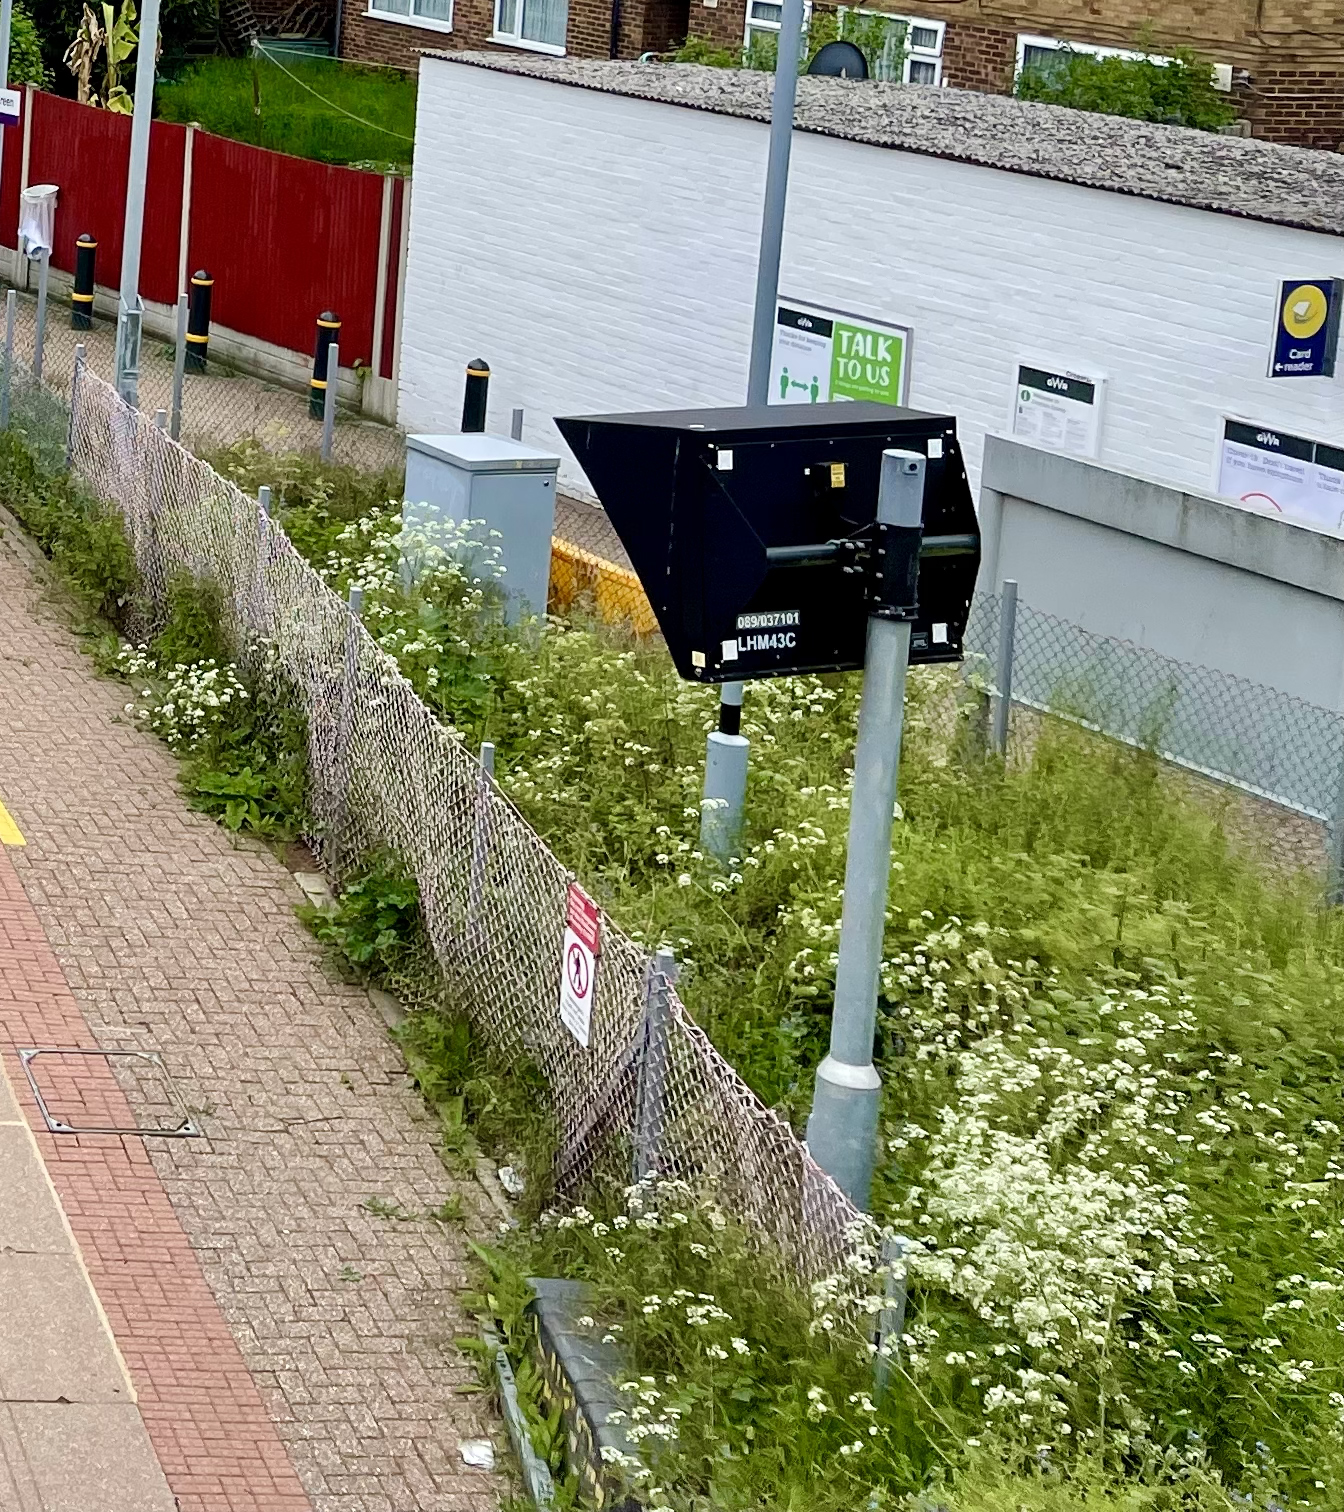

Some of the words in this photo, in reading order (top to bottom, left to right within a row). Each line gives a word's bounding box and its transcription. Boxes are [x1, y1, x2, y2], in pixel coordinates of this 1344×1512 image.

[838, 329, 893, 363] TALK
[1288, 348, 1312, 360] Card
[836, 357, 862, 380] TO
[865, 363, 890, 387] US
[1283, 361, 1314, 372] reader
[737, 612, 799, 629] 089/037101
[738, 632, 797, 652] LHM43C
